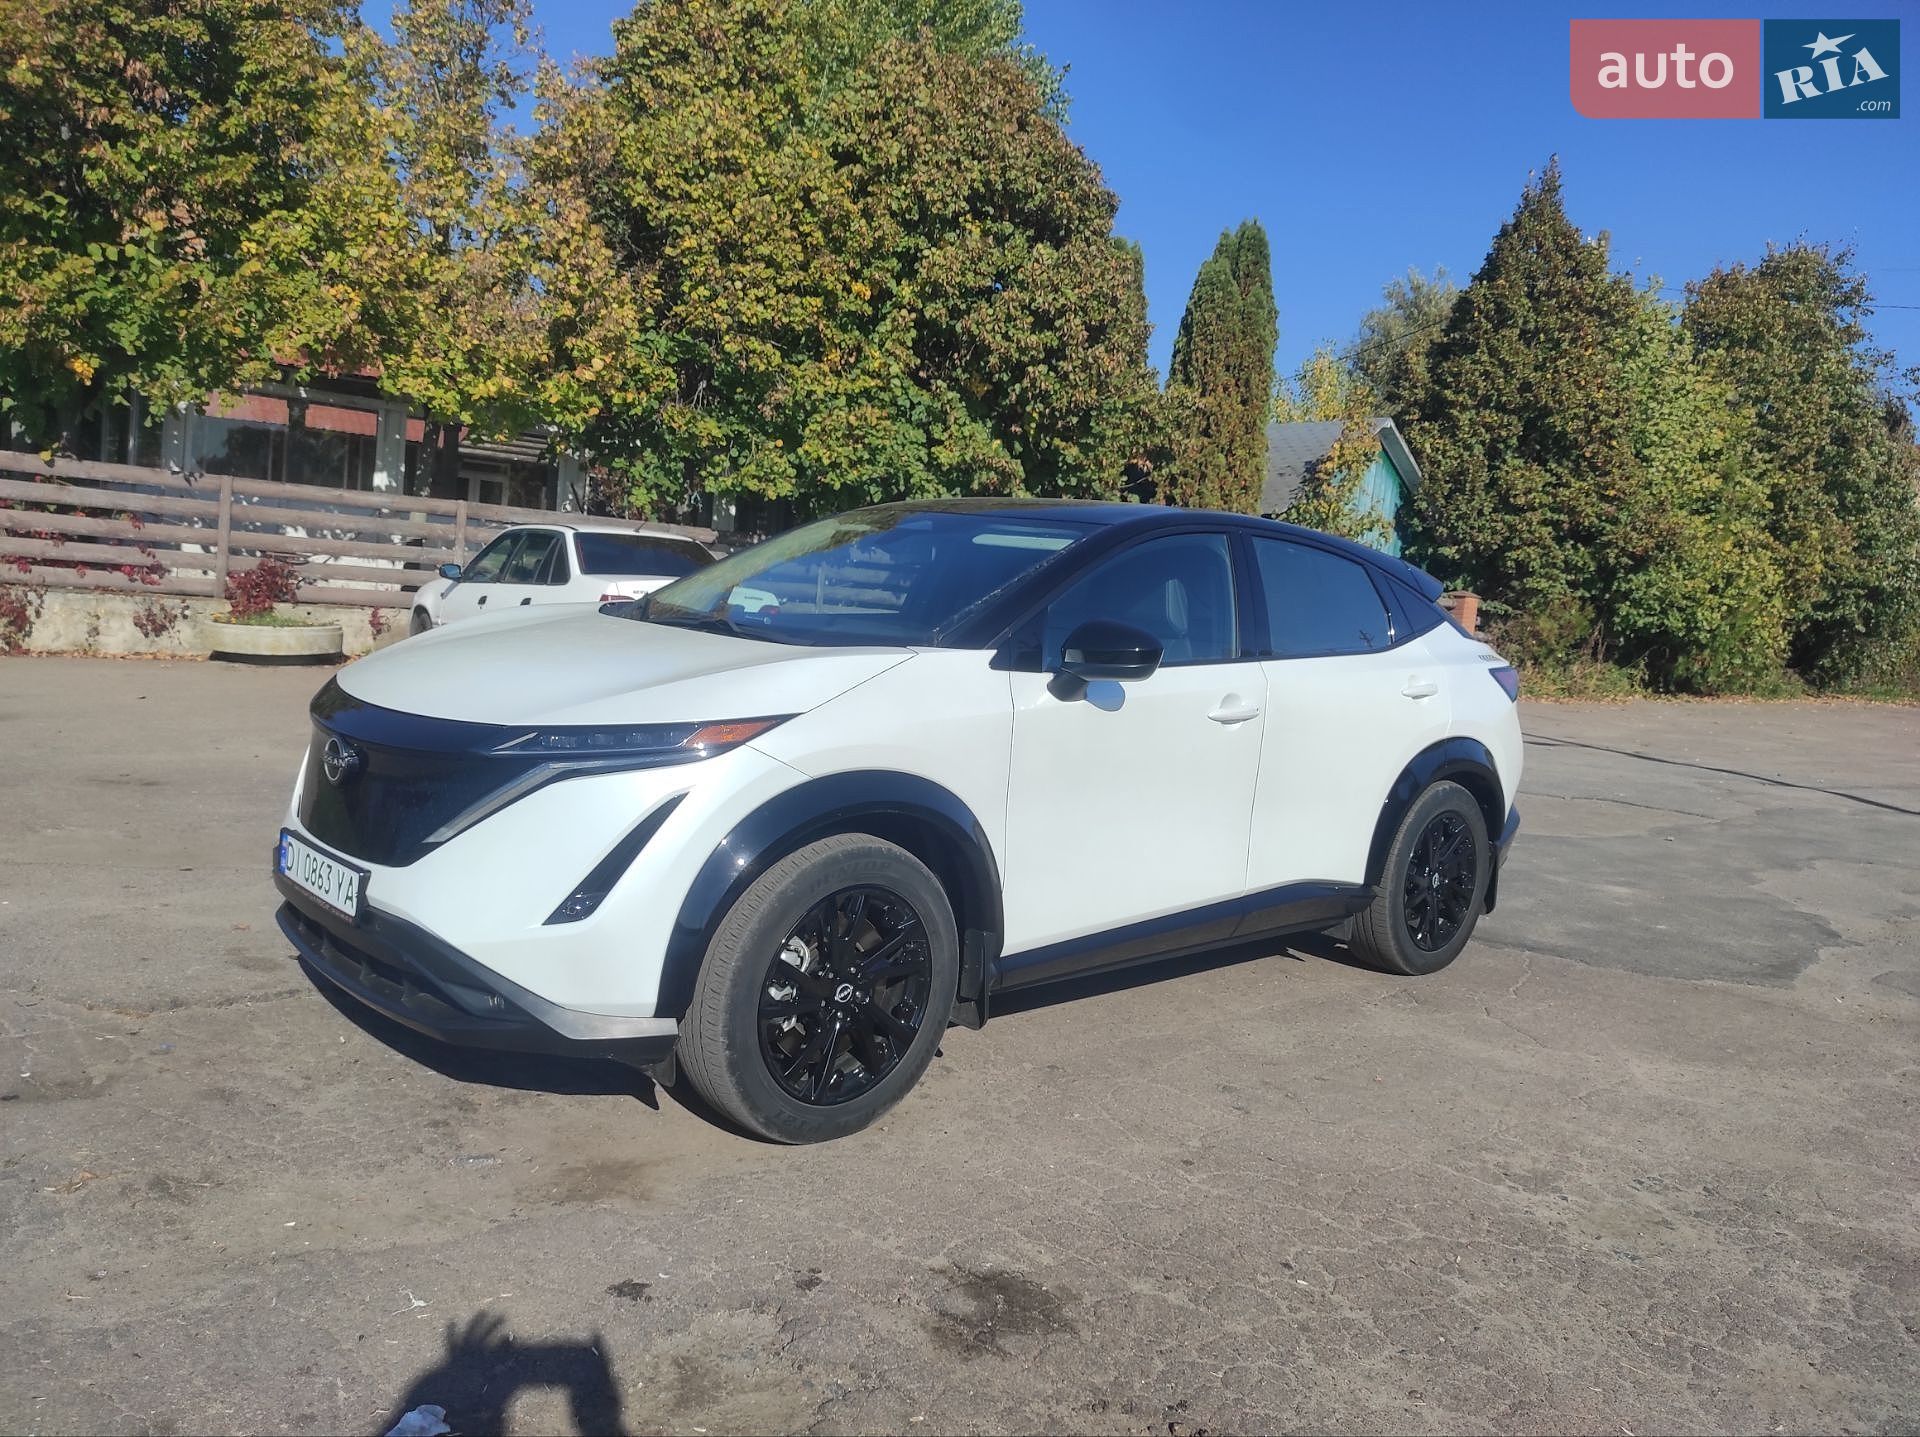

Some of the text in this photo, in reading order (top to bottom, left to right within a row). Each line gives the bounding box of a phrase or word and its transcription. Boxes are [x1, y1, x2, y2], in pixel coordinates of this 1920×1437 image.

[286, 842, 300, 877] DI
[304, 853, 332, 894] 0863
[337, 869, 354, 909] YA
